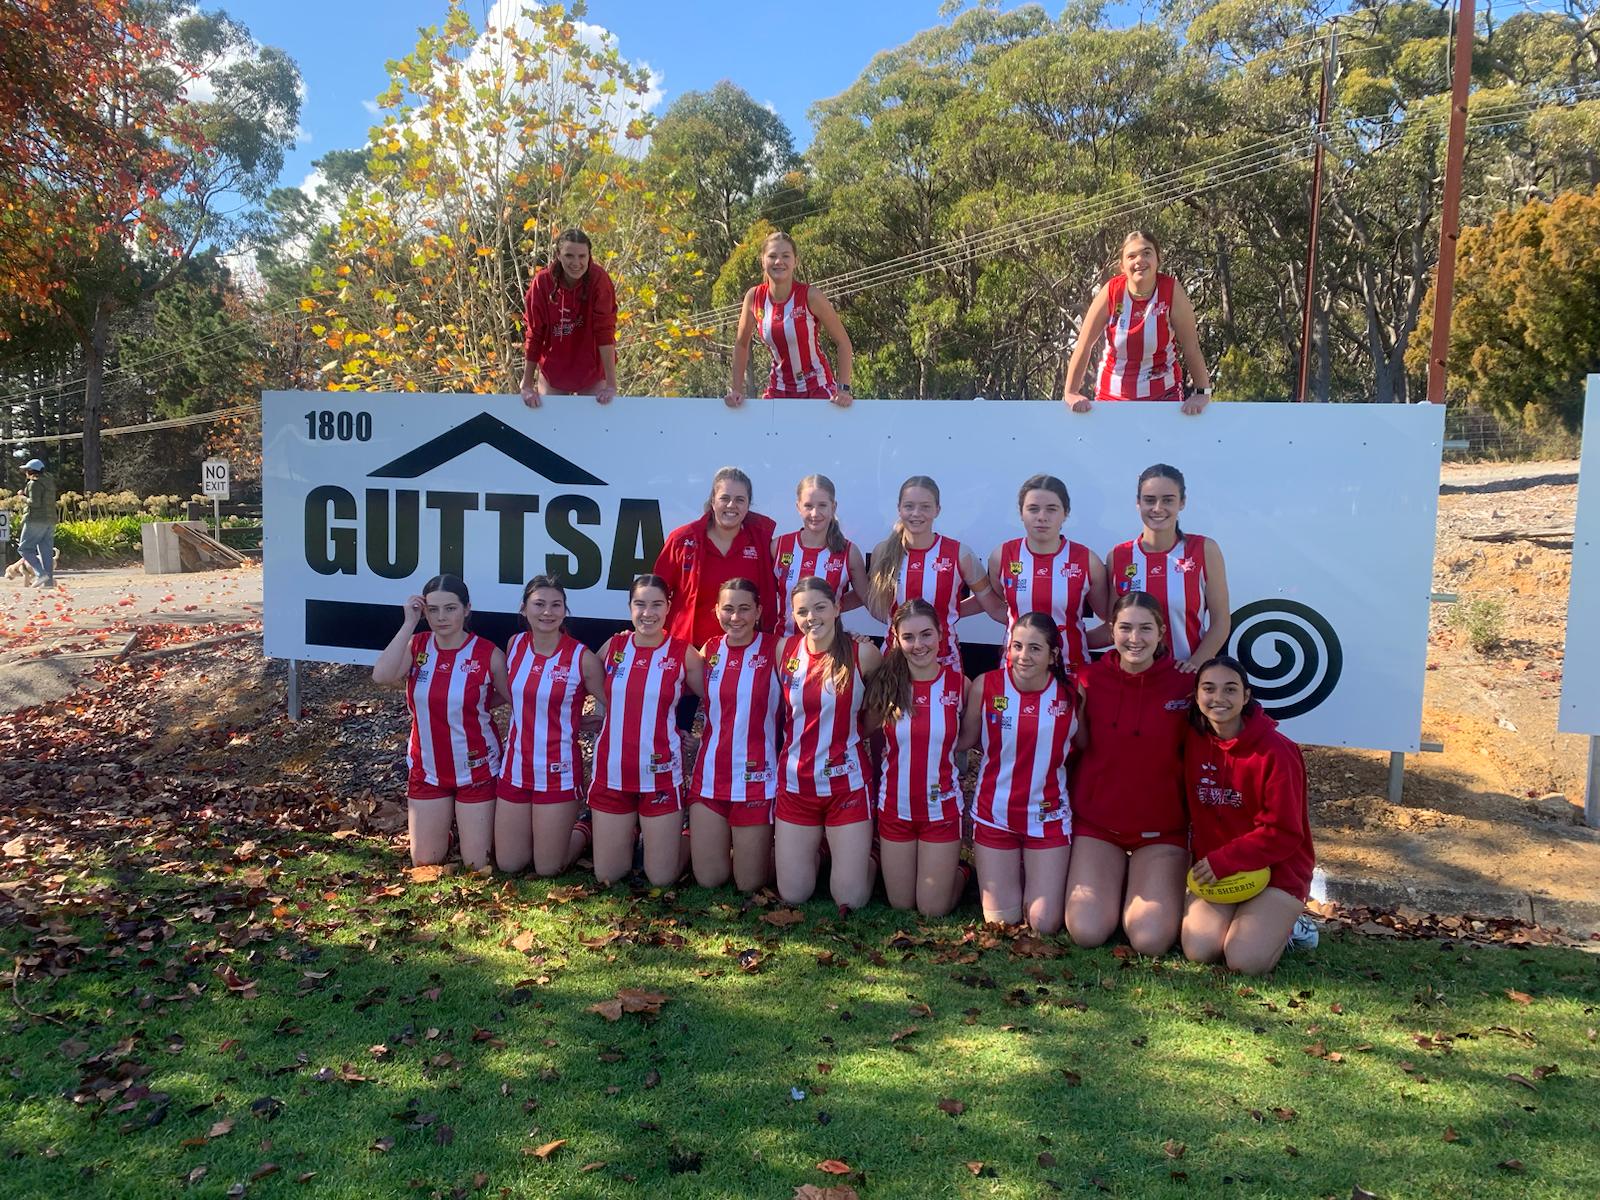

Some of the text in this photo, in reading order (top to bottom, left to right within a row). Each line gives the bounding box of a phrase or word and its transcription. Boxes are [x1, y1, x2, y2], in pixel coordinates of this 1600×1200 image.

[304, 410, 372, 442] 1800
[206, 465, 226, 479] NO
[205, 481, 226, 491] EXIT
[0, 514, 7, 527] O
[304, 484, 665, 592] GUTTSA
[1217, 881, 1256, 895] SHERRIN
